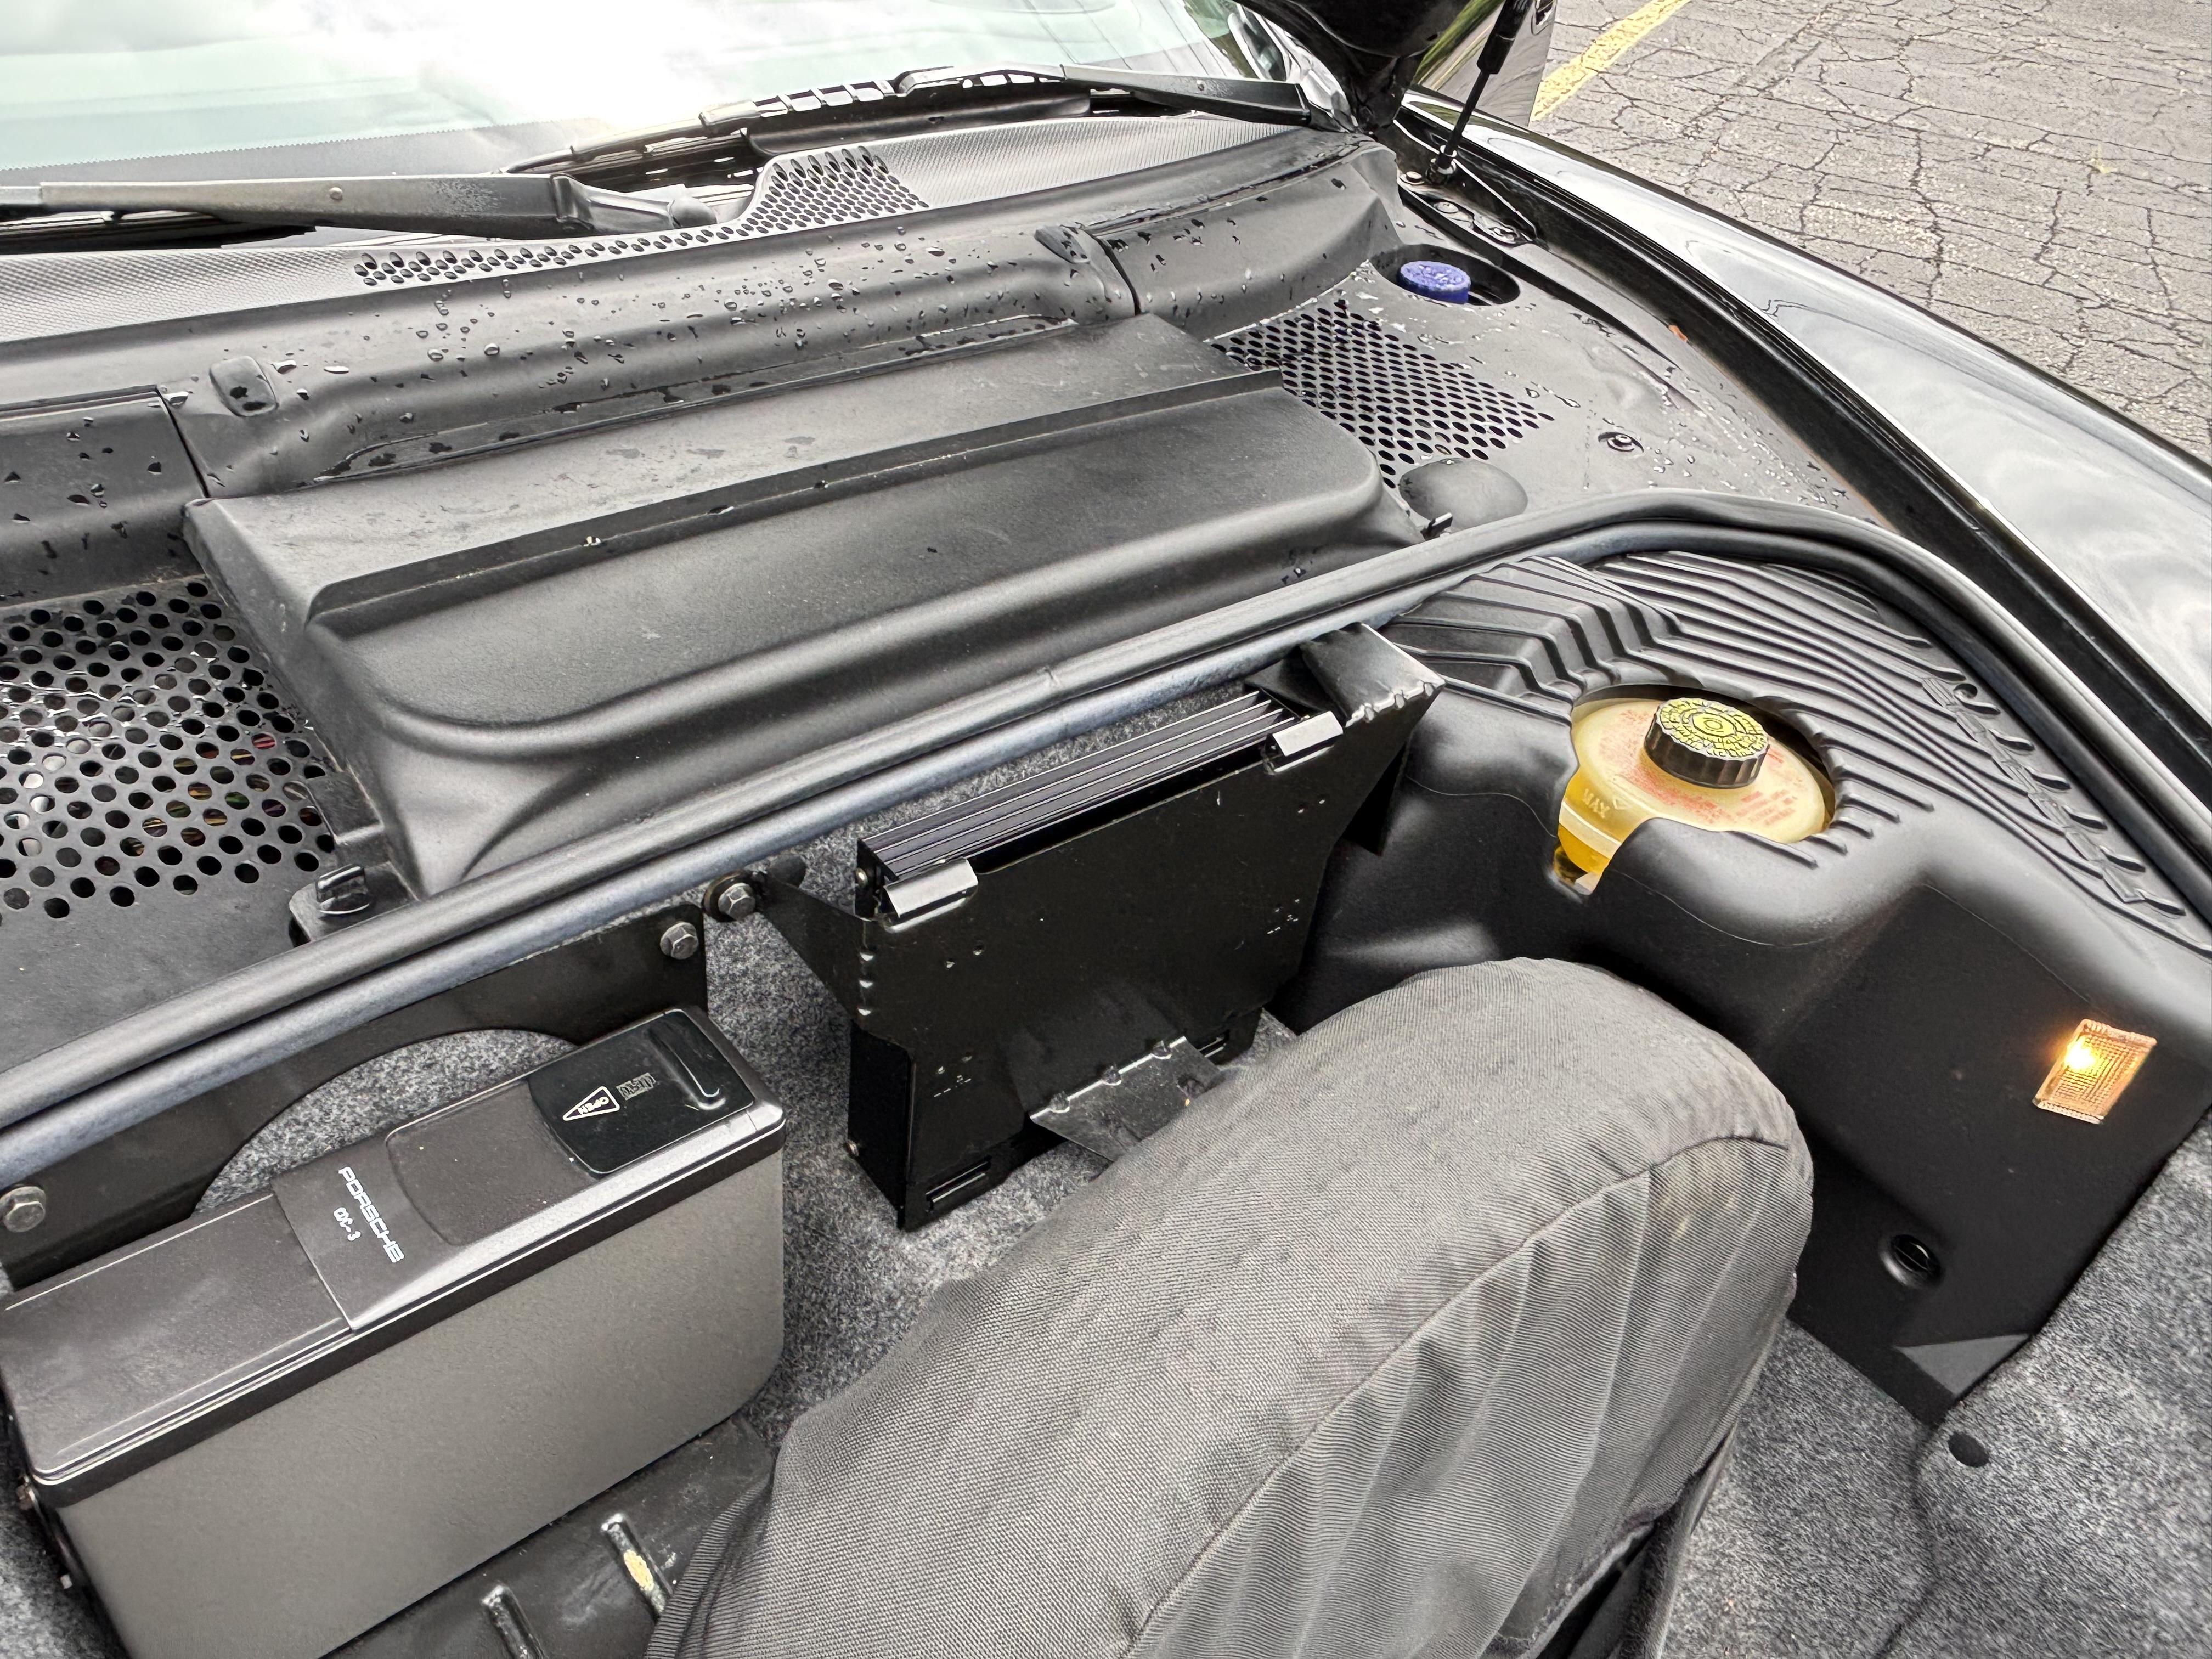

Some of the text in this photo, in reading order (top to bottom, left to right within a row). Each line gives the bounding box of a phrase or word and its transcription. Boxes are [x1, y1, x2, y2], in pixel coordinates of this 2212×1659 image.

[1582, 788, 1610, 819] MAX
[577, 1096, 610, 1115] OPEN
[338, 1166, 404, 1263] PORSCHE
